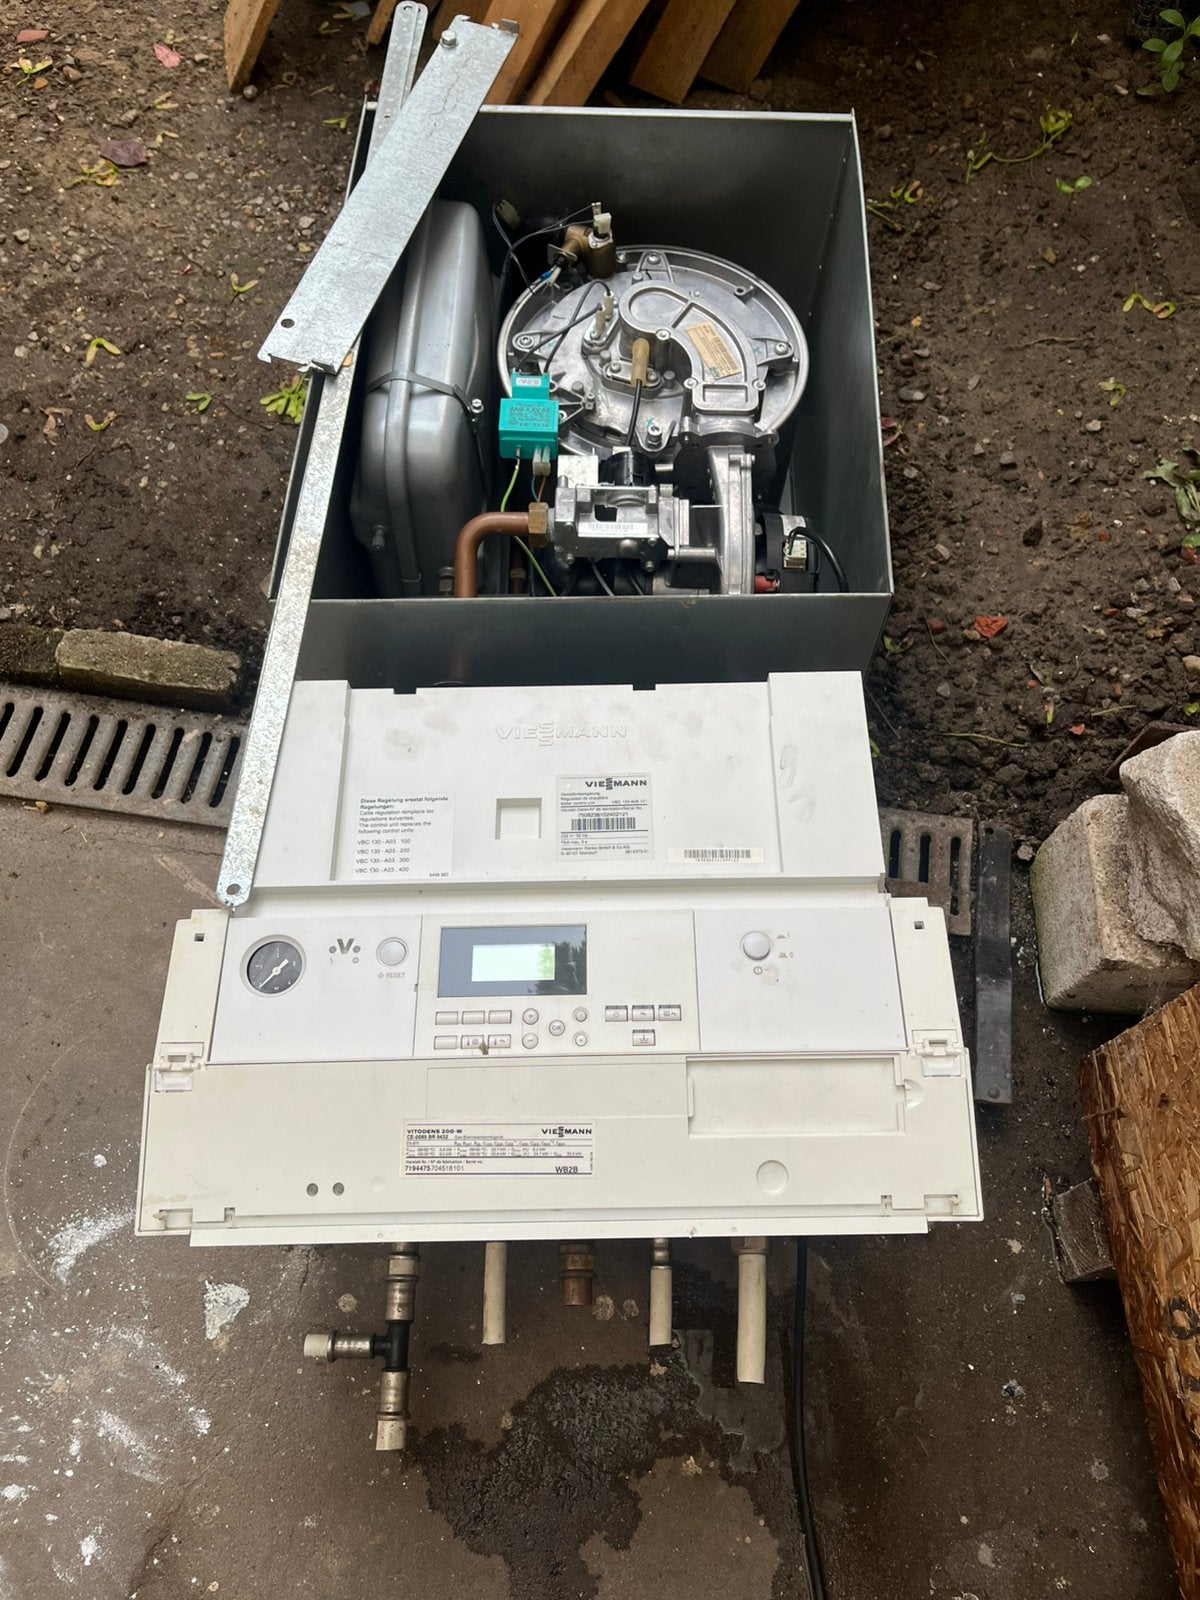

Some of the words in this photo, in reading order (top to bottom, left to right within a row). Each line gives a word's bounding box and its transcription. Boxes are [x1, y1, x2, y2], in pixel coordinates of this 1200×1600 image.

[494, 721, 628, 747] VIESSMANN
[585, 777, 647, 790] VIESSMANN
[541, 1126, 592, 1138] VIESSMANN
